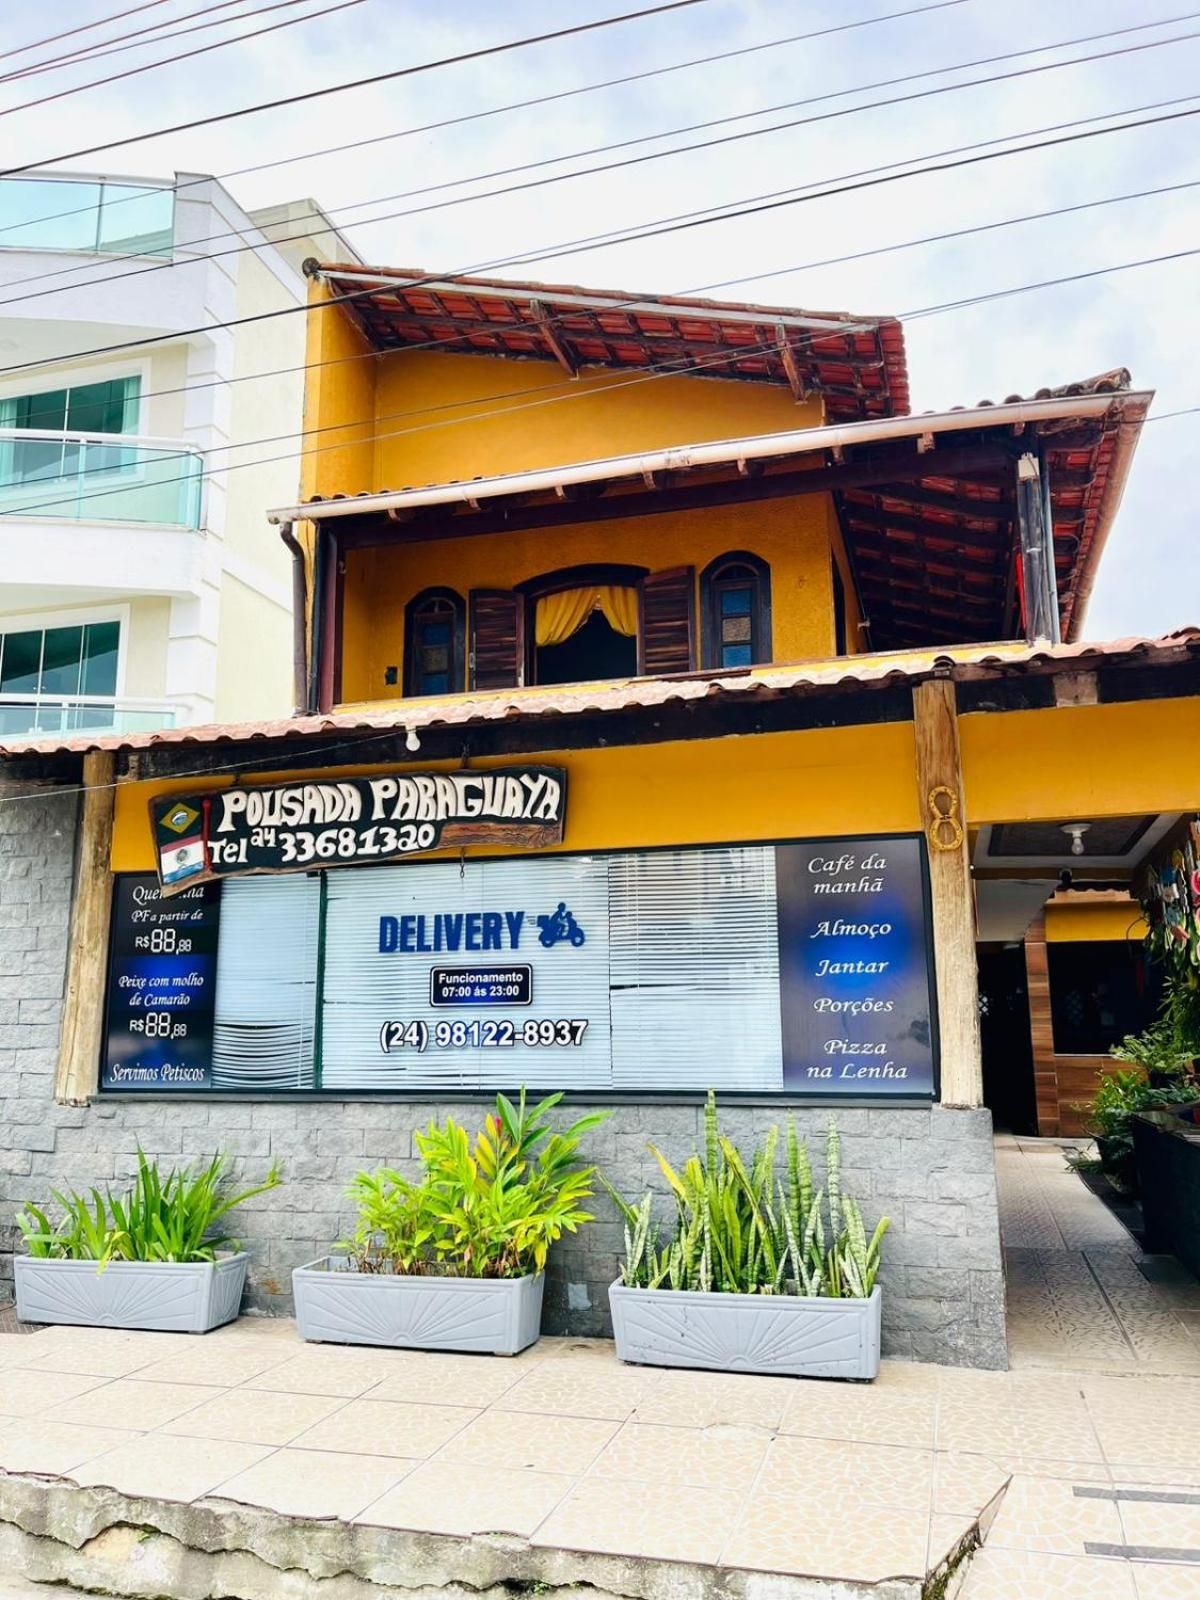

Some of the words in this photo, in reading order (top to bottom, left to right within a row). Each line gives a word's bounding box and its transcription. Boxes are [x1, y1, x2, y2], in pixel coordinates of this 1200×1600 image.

[216, 783, 362, 833] POUSADA
[368, 773, 561, 822] PARAGUAYA
[207, 838, 248, 863] Tel
[278, 823, 435, 862] 33681320
[808, 854, 856, 876] Café
[860, 853, 887, 870] da
[814, 876, 884, 894] manhã
[158, 910, 190, 924] partir
[190, 909, 204, 921] de
[379, 911, 525, 953] DELIVERY
[810, 919, 892, 939] Almoço
[815, 959, 889, 977] Jantar
[118, 975, 147, 990] Peixe
[148, 976, 170, 987] com
[172, 972, 204, 987] molho
[438, 972, 523, 985] Funcionamento
[129, 992, 142, 1006] de
[143, 993, 191, 1007] Camarão
[442, 986, 471, 998] 07:00
[473, 985, 487, 997] ás
[489, 984, 520, 997] 23:00
[813, 997, 894, 1016] Porções
[380, 1021, 428, 1053] (24)
[435, 1019, 589, 1047] 98122-8937
[823, 1039, 888, 1055] Pizza
[110, 1062, 159, 1083] Servimos
[160, 1062, 205, 1082] Petiscos
[806, 1065, 833, 1078] na
[840, 1061, 909, 1079] Lenha
